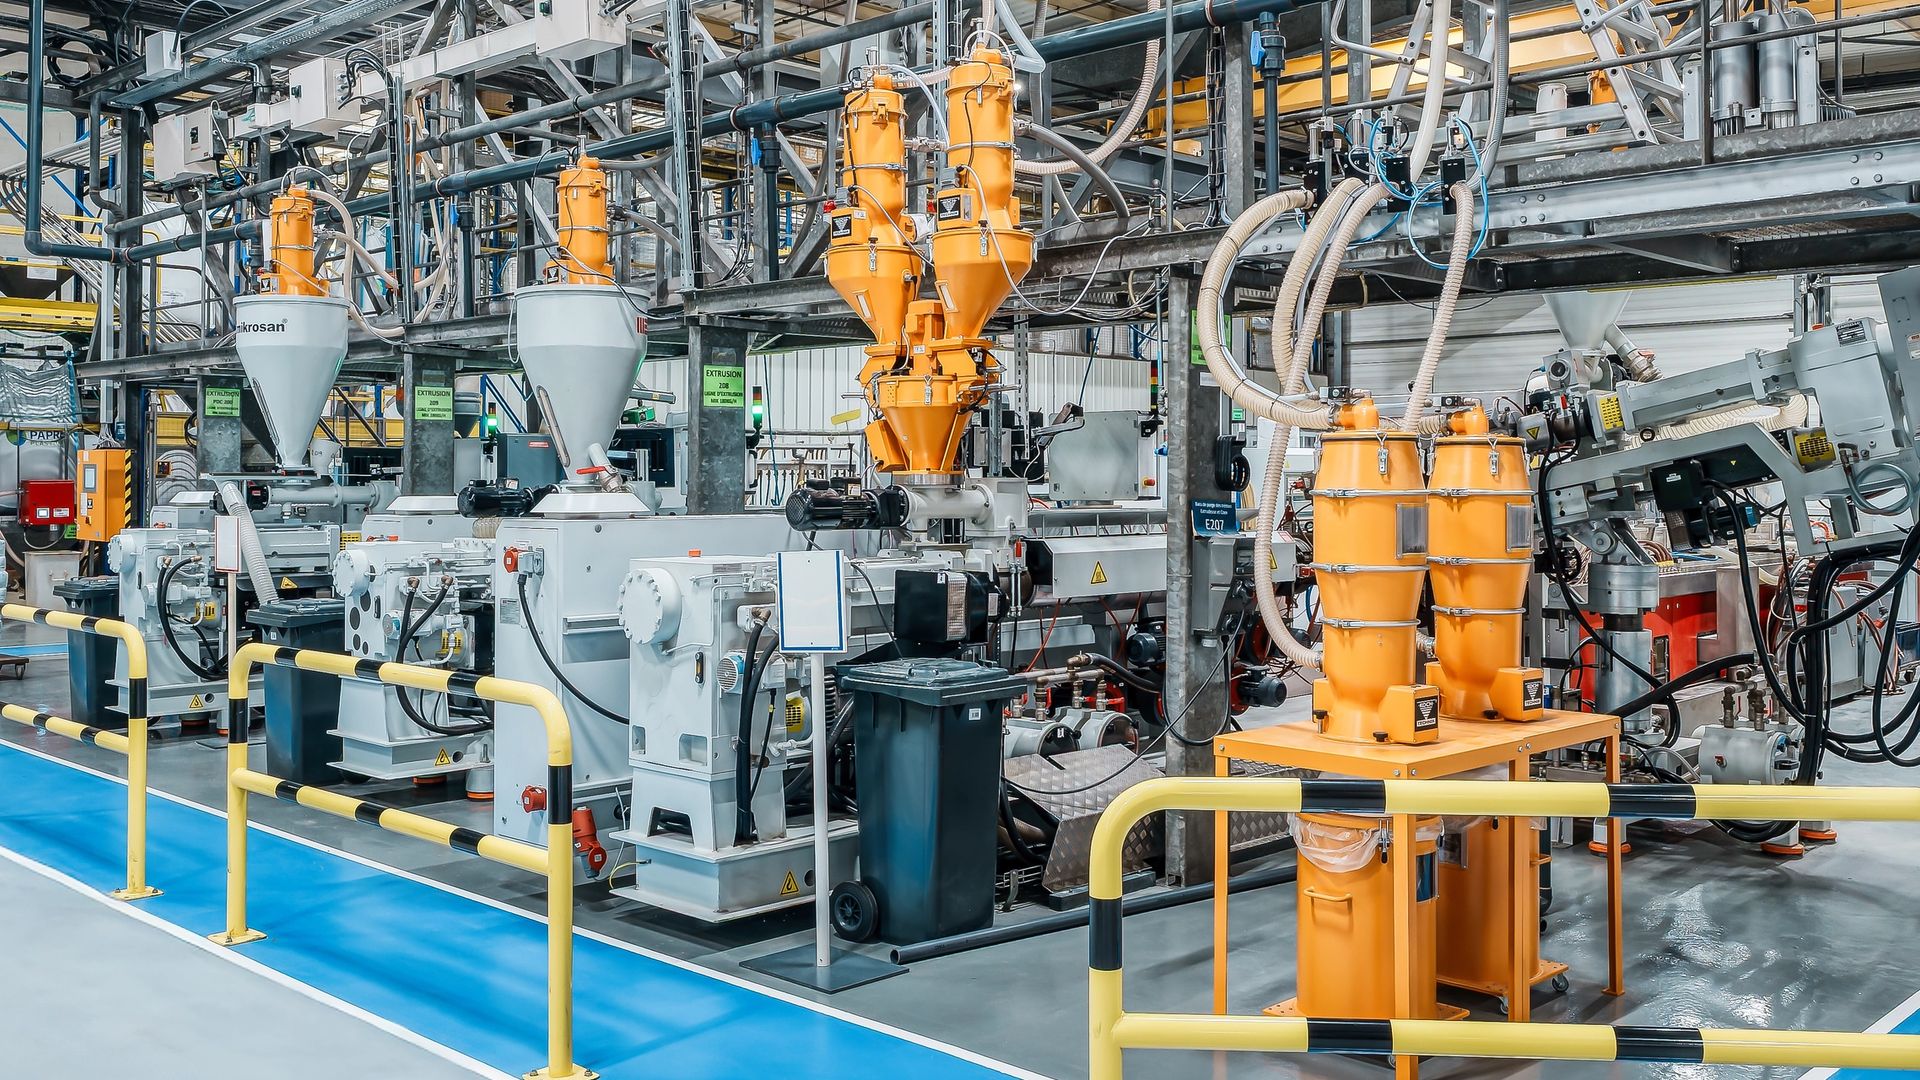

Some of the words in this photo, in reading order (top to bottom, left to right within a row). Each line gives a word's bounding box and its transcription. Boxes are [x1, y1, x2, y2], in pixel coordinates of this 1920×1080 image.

[706, 369, 742, 378] EXTRUSION
[417, 389, 451, 397] EXTRUSION
[1205, 518, 1224, 531] E207
